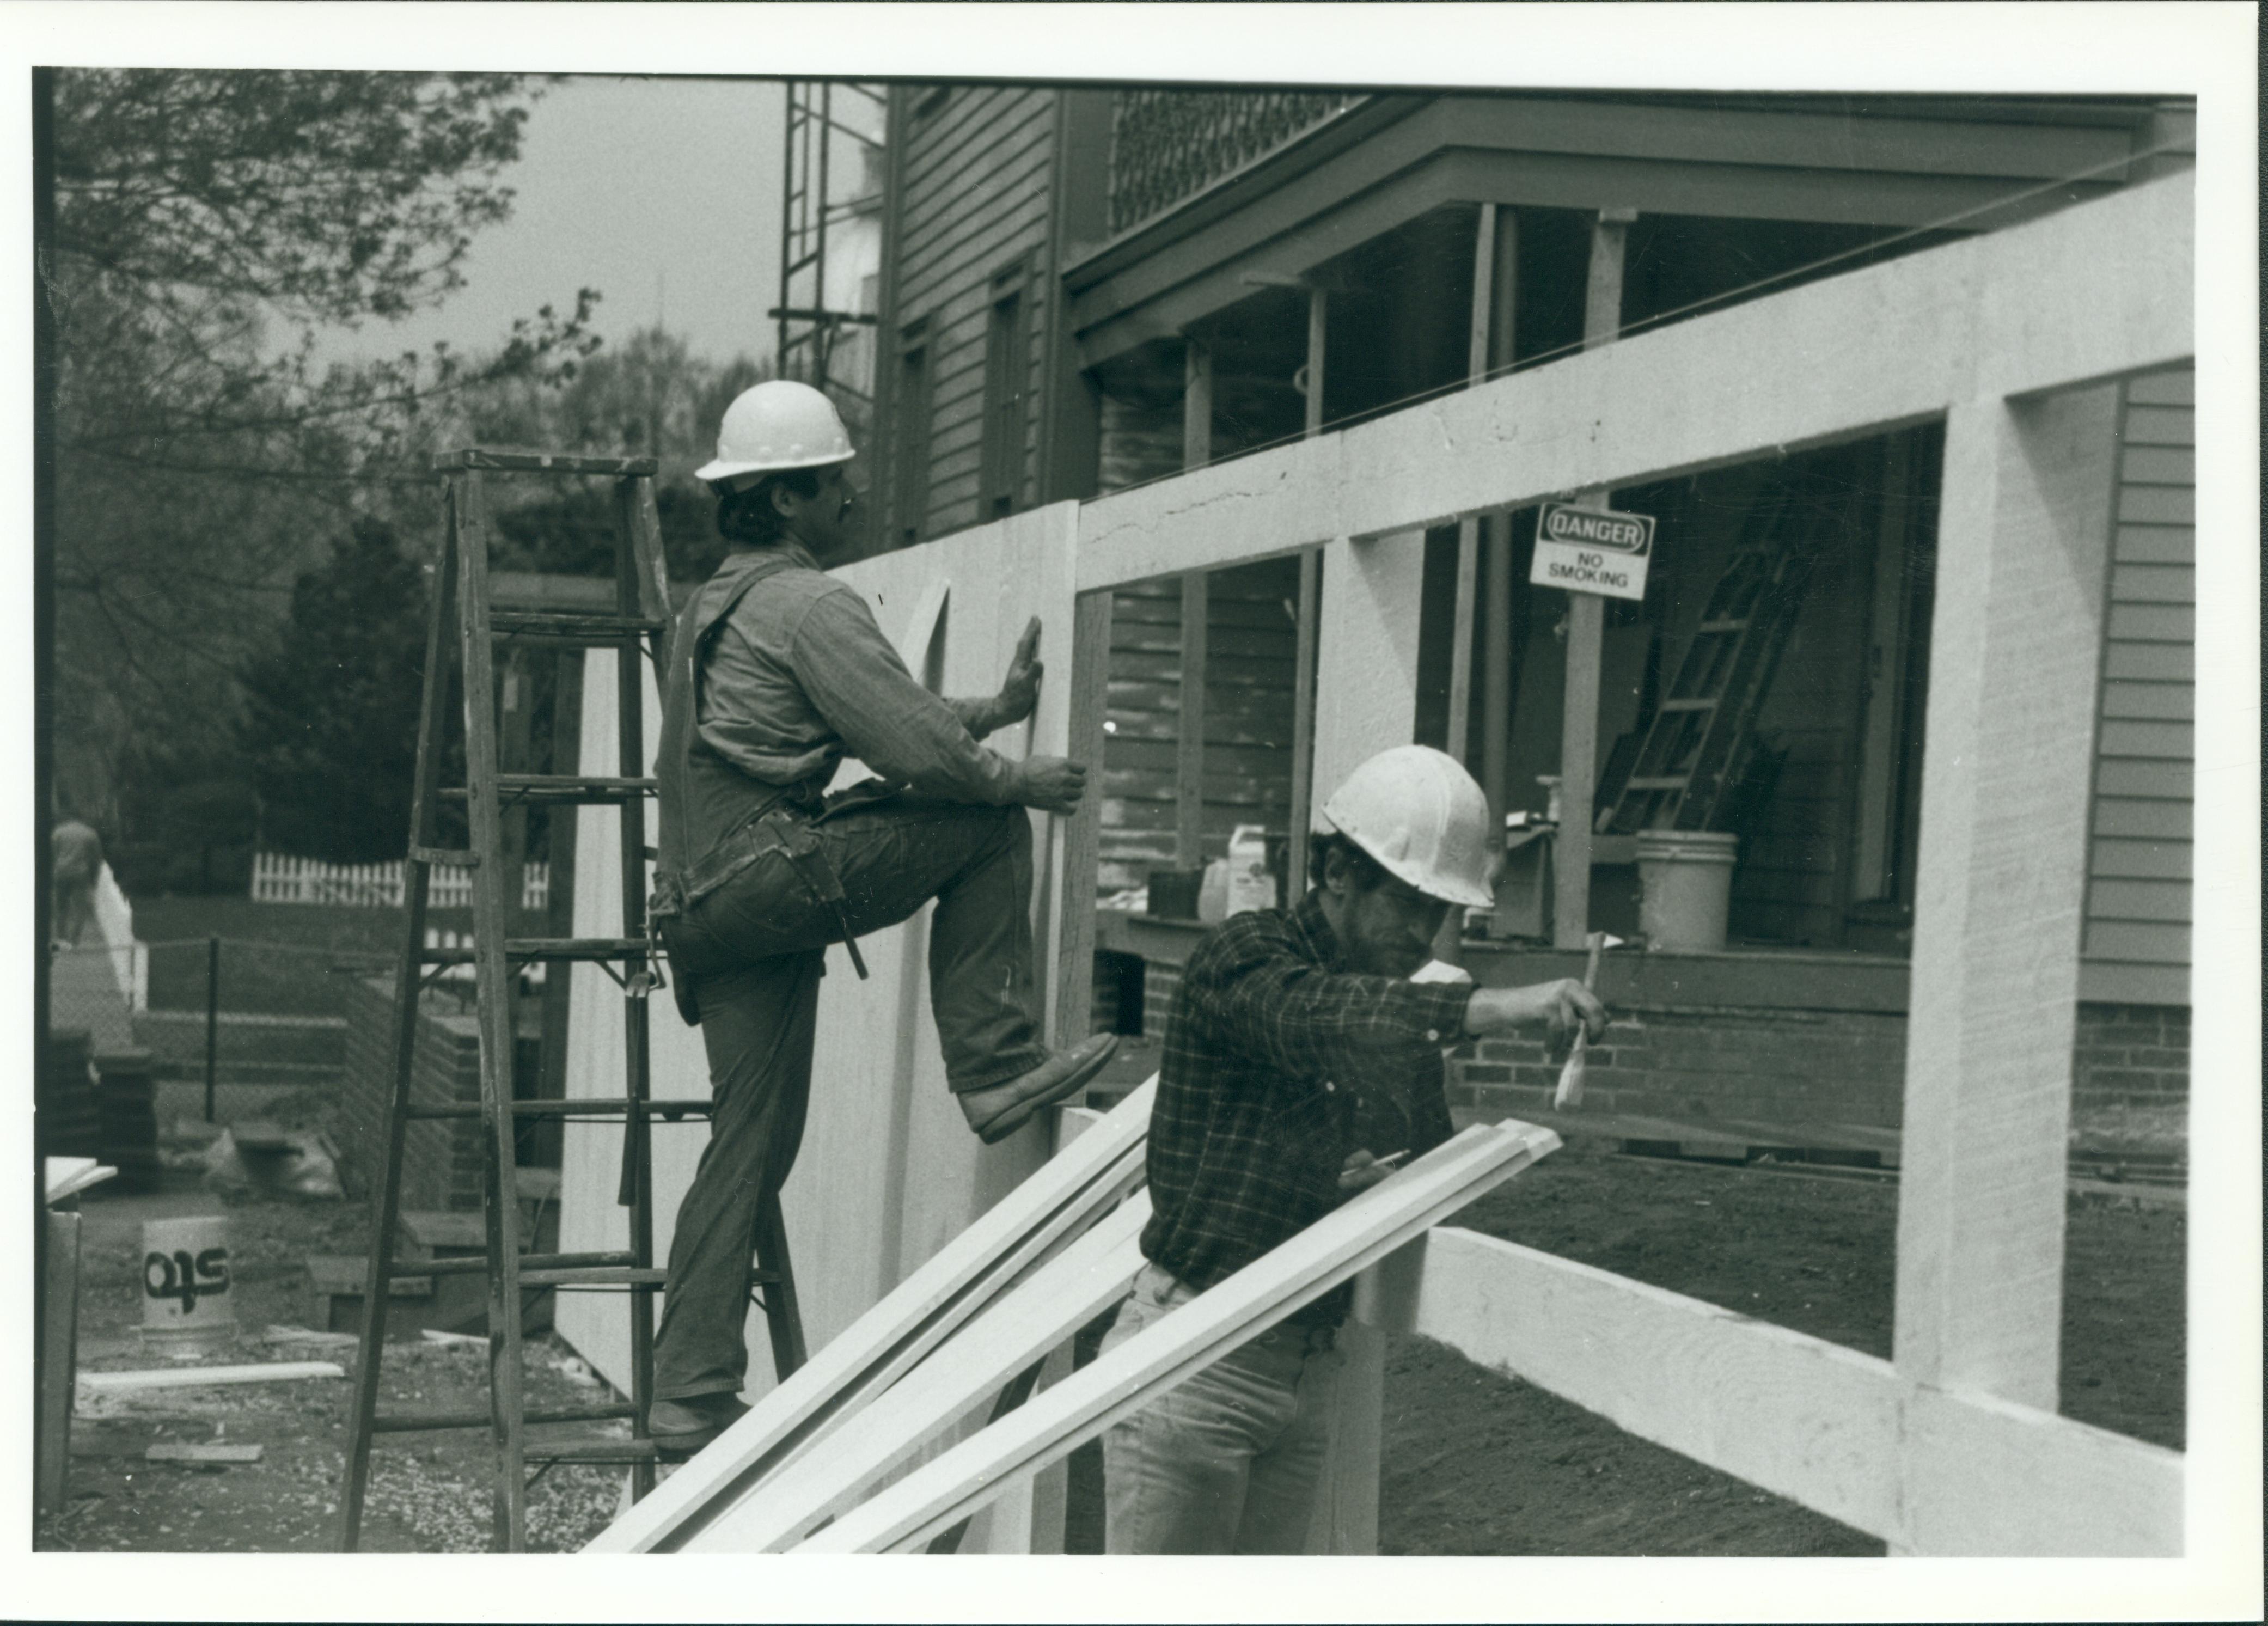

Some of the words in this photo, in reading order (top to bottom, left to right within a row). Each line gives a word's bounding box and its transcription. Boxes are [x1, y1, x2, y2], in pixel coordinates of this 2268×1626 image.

[1553, 514, 1639, 545] DANGER
[1579, 552, 1603, 568] NO
[1549, 563, 1628, 588] SMOKING
[145, 1247, 230, 1315] sto
